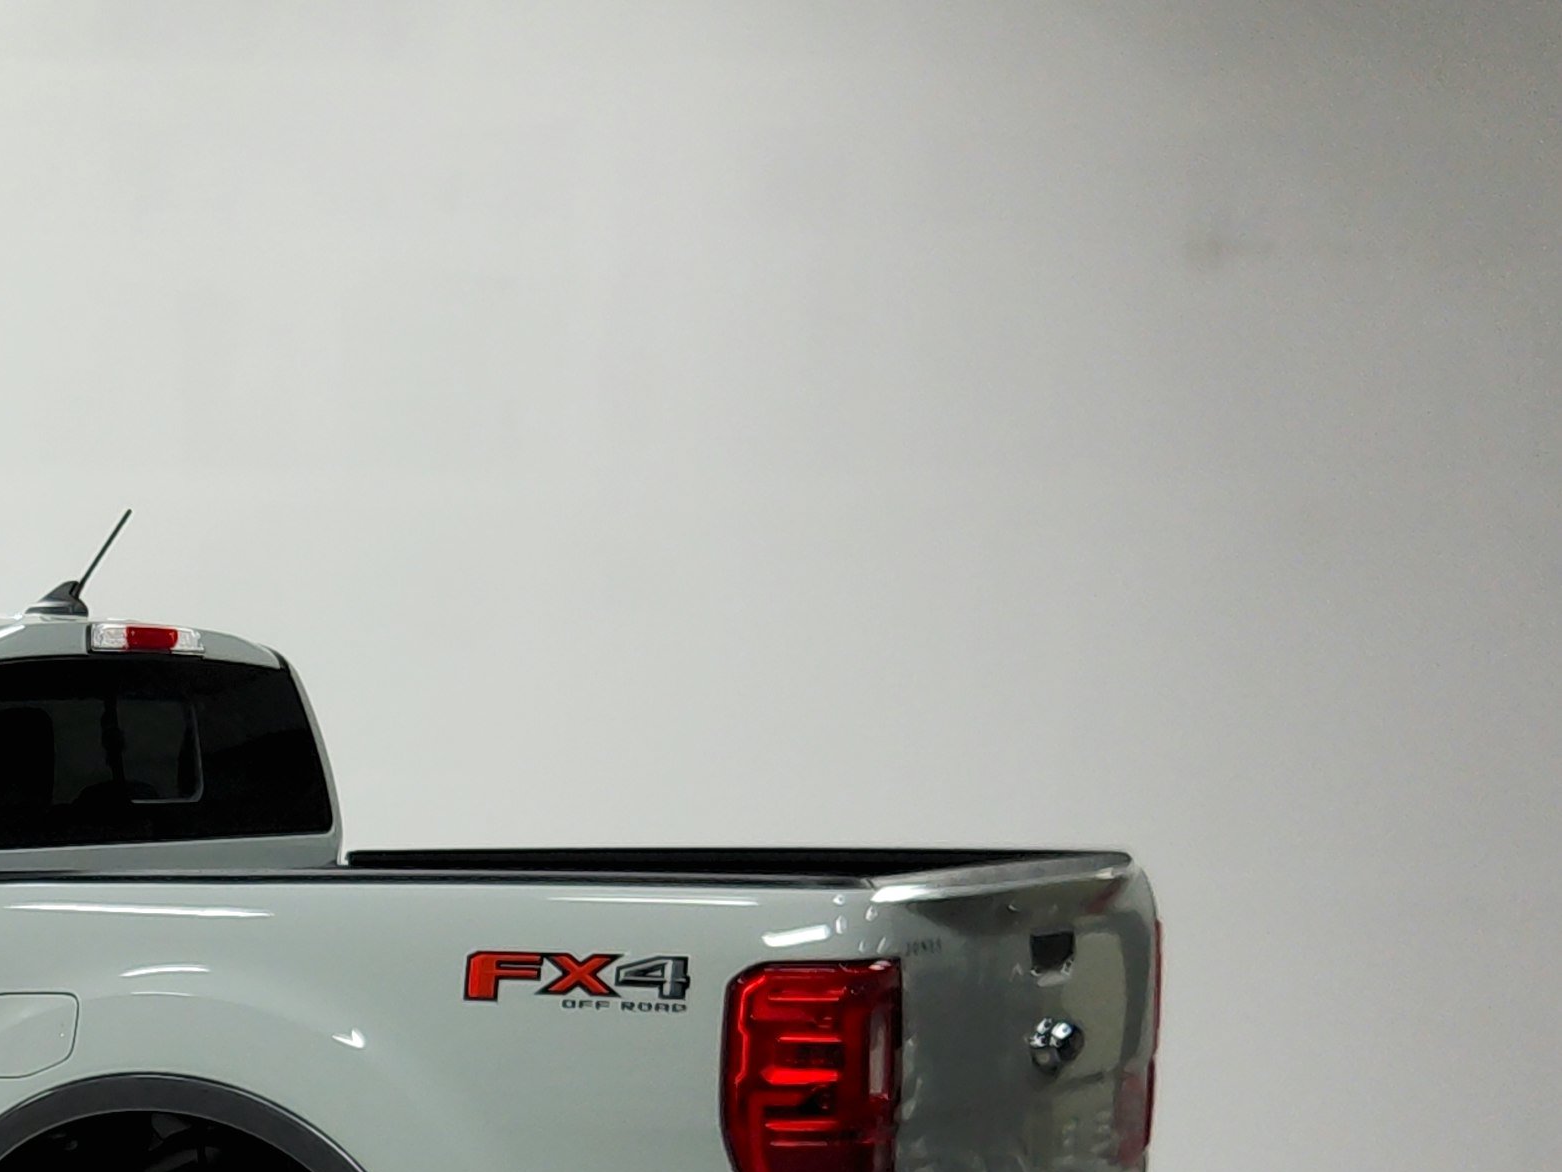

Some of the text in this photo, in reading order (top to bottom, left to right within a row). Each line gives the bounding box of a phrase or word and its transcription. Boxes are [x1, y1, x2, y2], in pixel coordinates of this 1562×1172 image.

[464, 950, 690, 1002] FX4
[561, 999, 688, 1013] OFF ROAD
